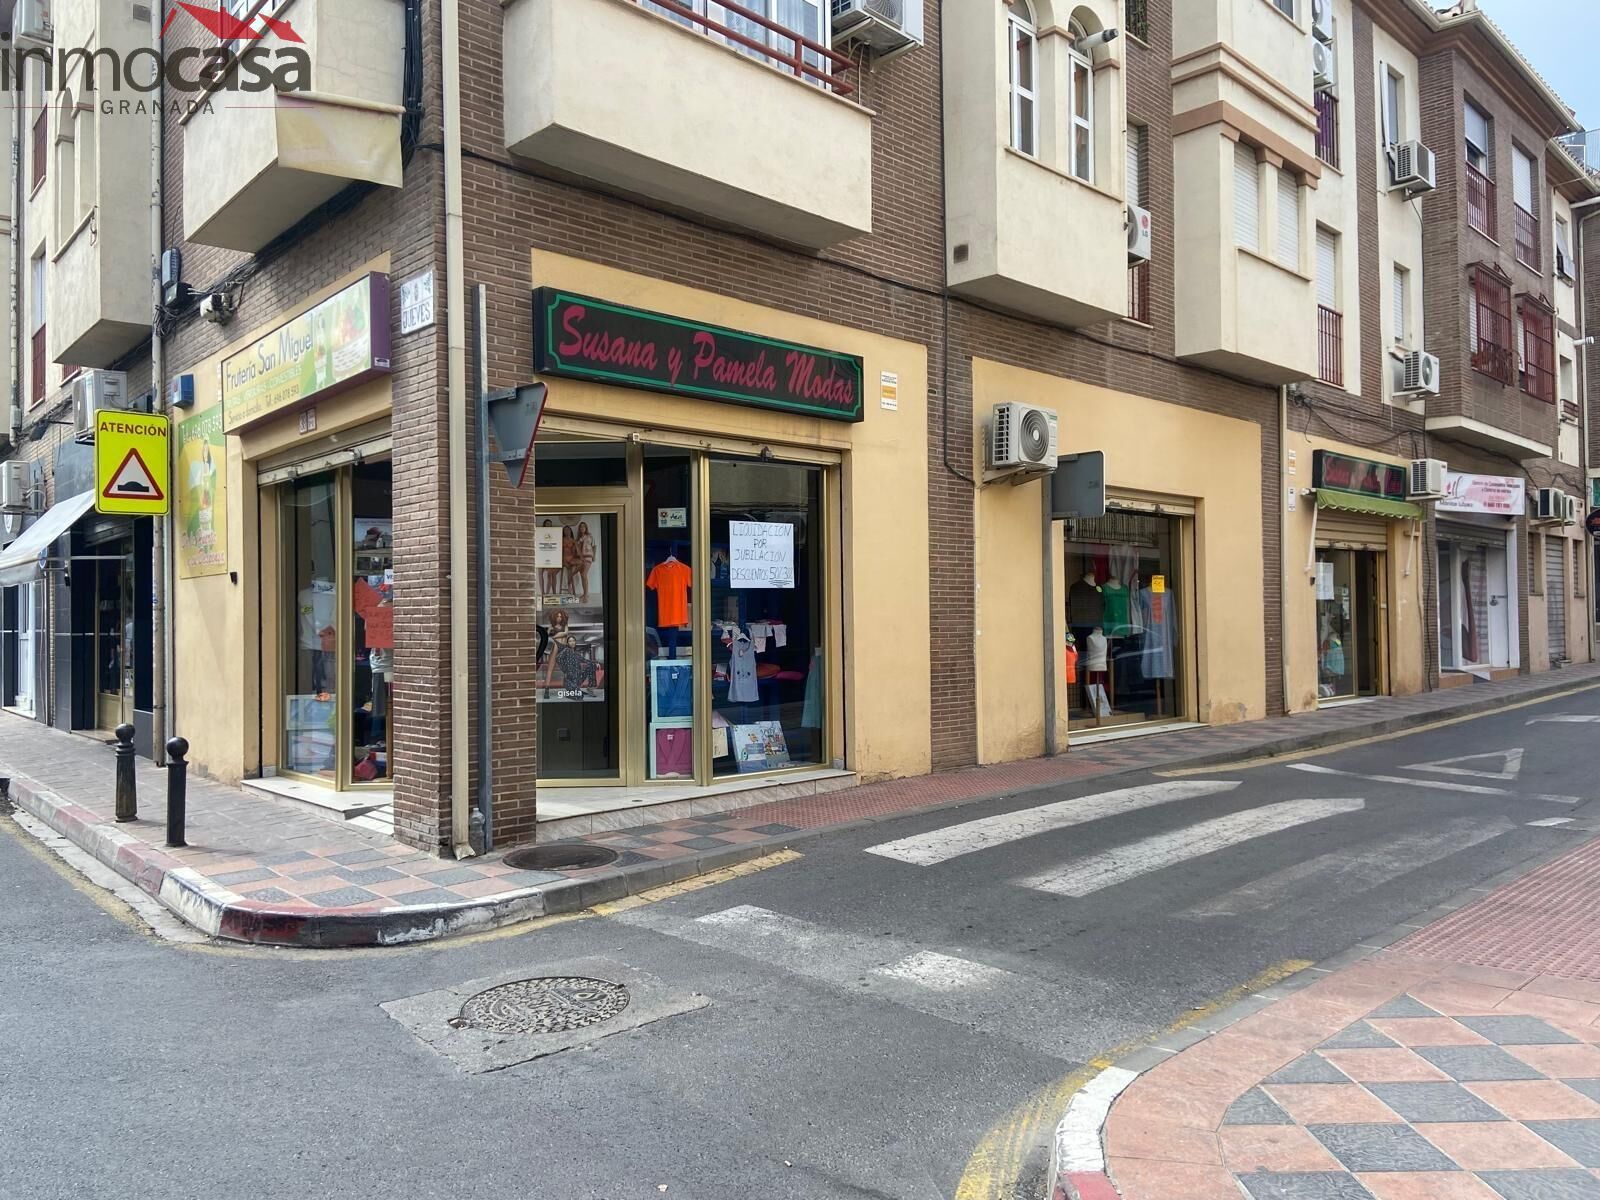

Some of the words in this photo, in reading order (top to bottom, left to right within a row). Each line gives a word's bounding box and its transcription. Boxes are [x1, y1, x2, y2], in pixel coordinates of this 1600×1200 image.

[402, 301, 431, 329] JUEVES
[226, 361, 256, 392] Frutería
[258, 341, 276, 376] San
[279, 313, 314, 366] Miguel
[559, 304, 658, 371] Susana
[667, 346, 683, 386] y
[692, 331, 777, 391] Pamela
[785, 350, 854, 404] Modas
[100, 422, 167, 437] ATENCIÓN
[732, 523, 792, 537] LIQUIDACION
[753, 538, 768, 548] POR
[733, 549, 787, 562] JUBILACION
[557, 689, 583, 699] gisela
